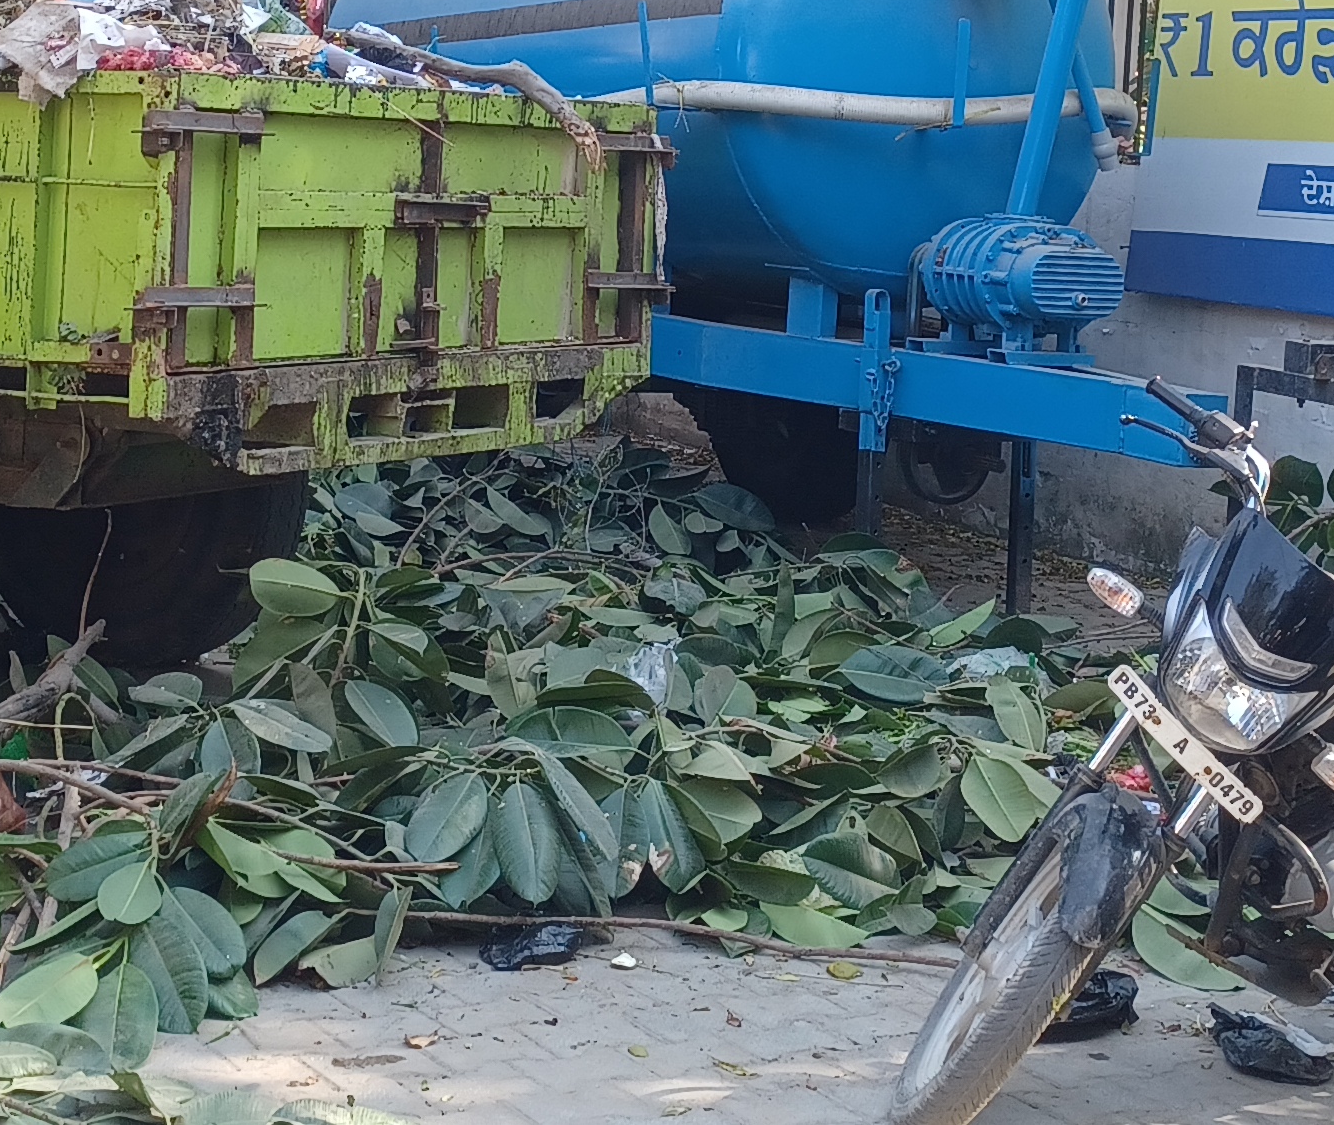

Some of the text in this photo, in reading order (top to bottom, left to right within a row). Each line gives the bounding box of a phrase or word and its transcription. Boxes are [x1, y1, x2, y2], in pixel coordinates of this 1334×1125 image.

[1113, 671, 1255, 817] PB73 A 0479
